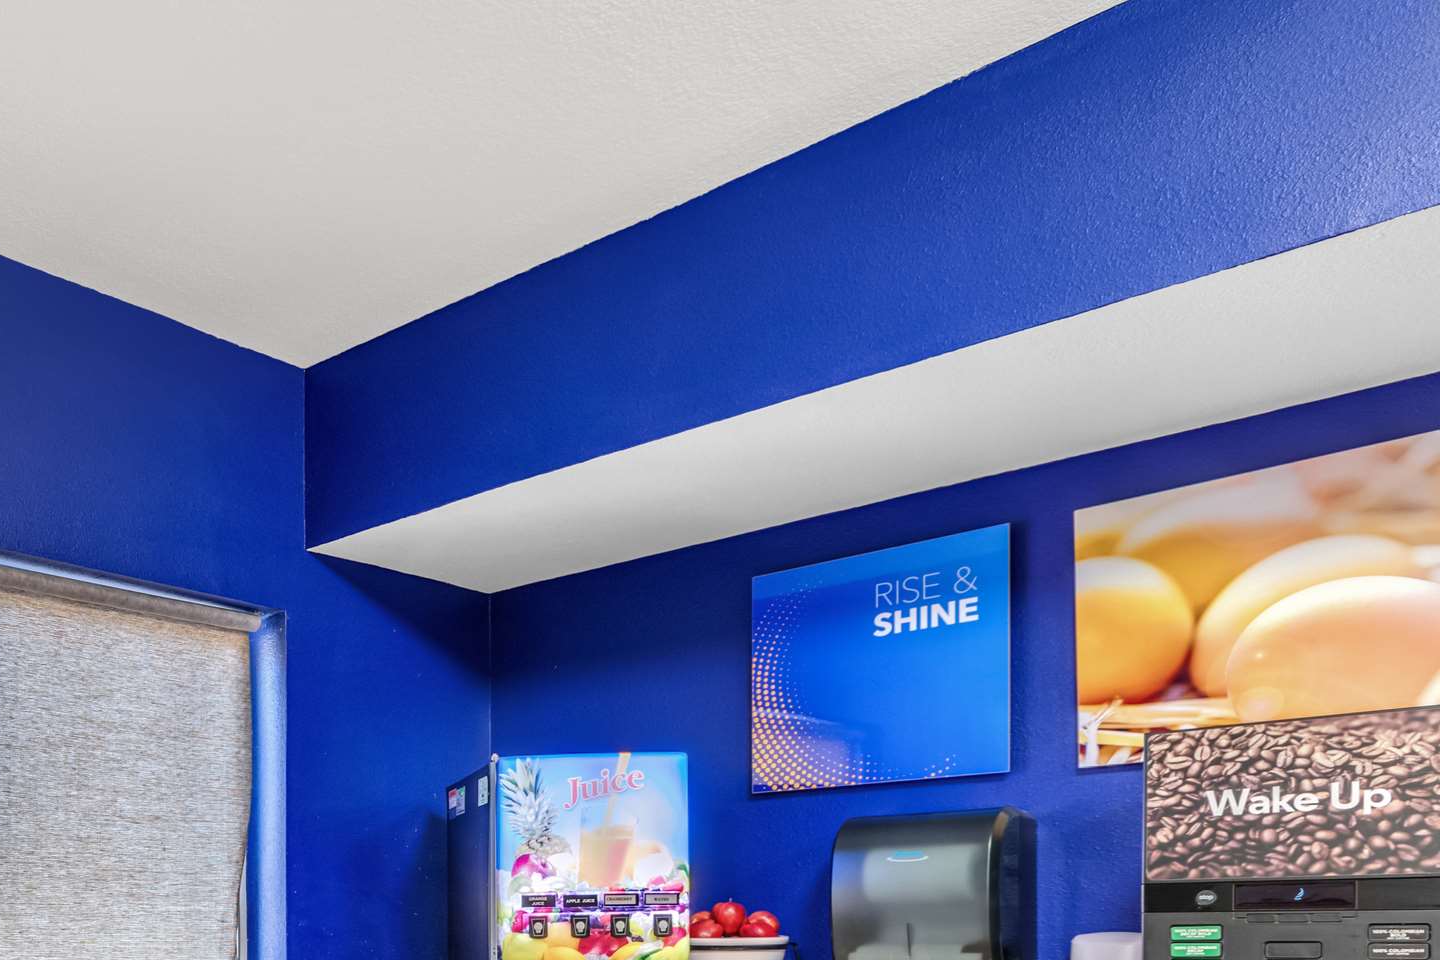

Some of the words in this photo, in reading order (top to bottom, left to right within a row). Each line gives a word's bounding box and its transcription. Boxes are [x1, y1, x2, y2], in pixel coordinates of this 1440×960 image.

[875, 571, 941, 608] RISE
[953, 565, 978, 594] &
[872, 596, 979, 637] SHINE
[563, 768, 646, 811] Juice
[1207, 785, 1321, 817] Wake
[1329, 780, 1393, 816] Up
